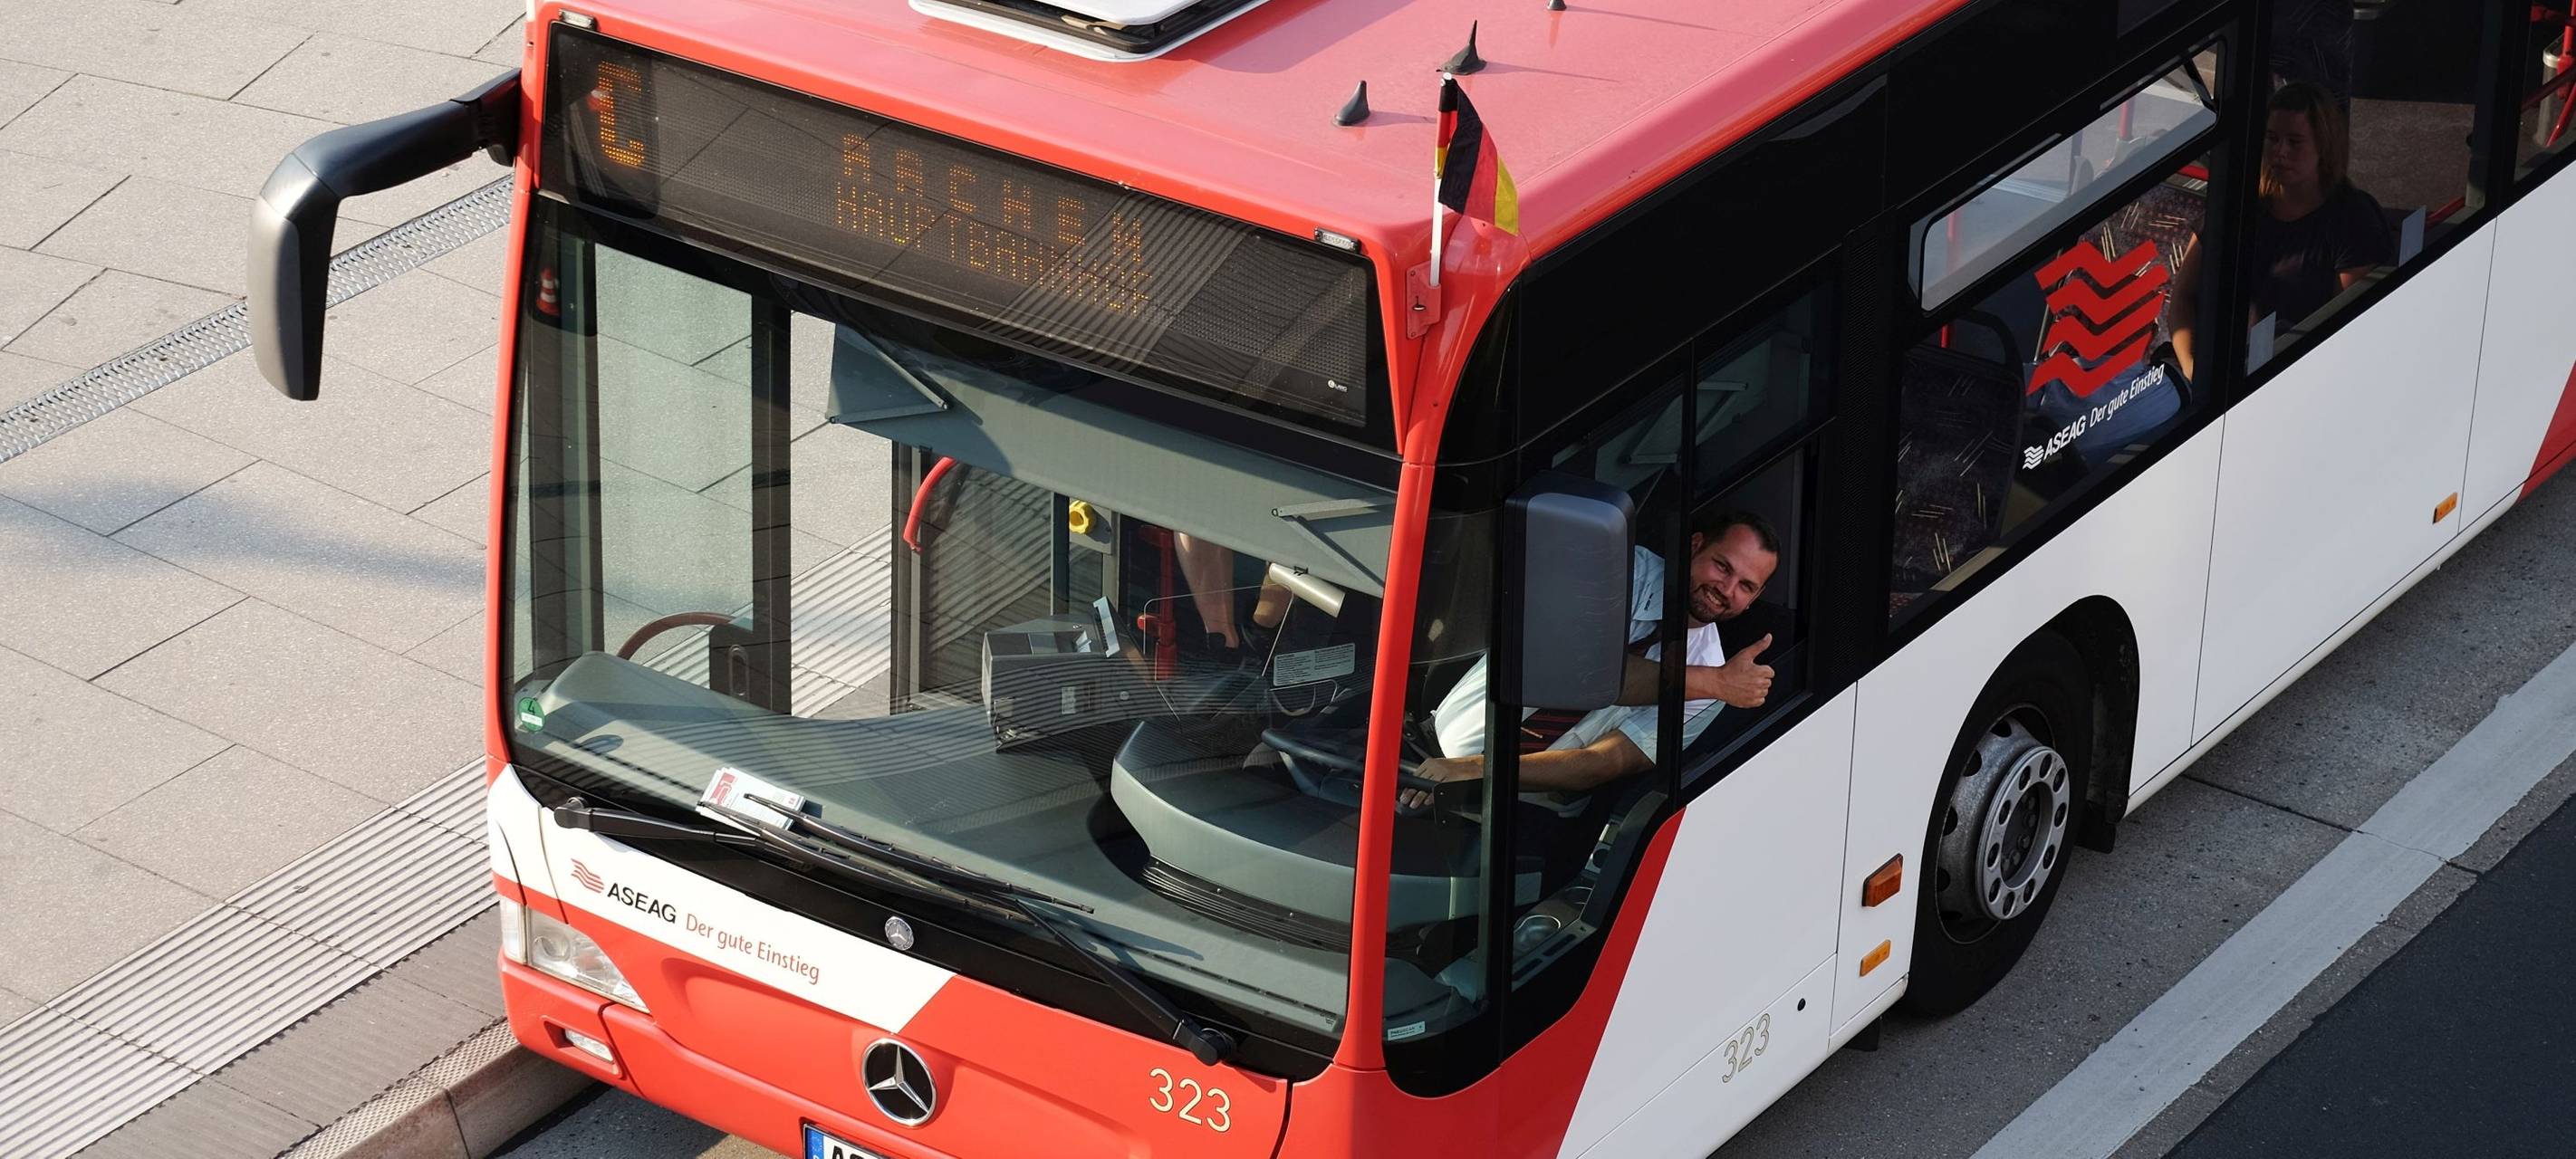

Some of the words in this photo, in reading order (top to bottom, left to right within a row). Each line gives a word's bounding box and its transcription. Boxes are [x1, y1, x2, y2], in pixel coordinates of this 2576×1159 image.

[597, 62, 645, 168] C
[836, 182, 1152, 316] HAUPTBAHNHOF
[842, 134, 1142, 263] AACHEN
[2043, 415, 2086, 460] ASEAG
[2090, 404, 2108, 427] Der
[2107, 389, 2129, 421] gute
[2129, 363, 2166, 399] Einstieg
[607, 882, 678, 924] ASEAG
[686, 913, 713, 939] Der
[716, 929, 754, 954] gute
[757, 941, 821, 984] Einstieg
[1722, 1012, 1772, 1084] 323
[1149, 1067, 1232, 1133] 323
